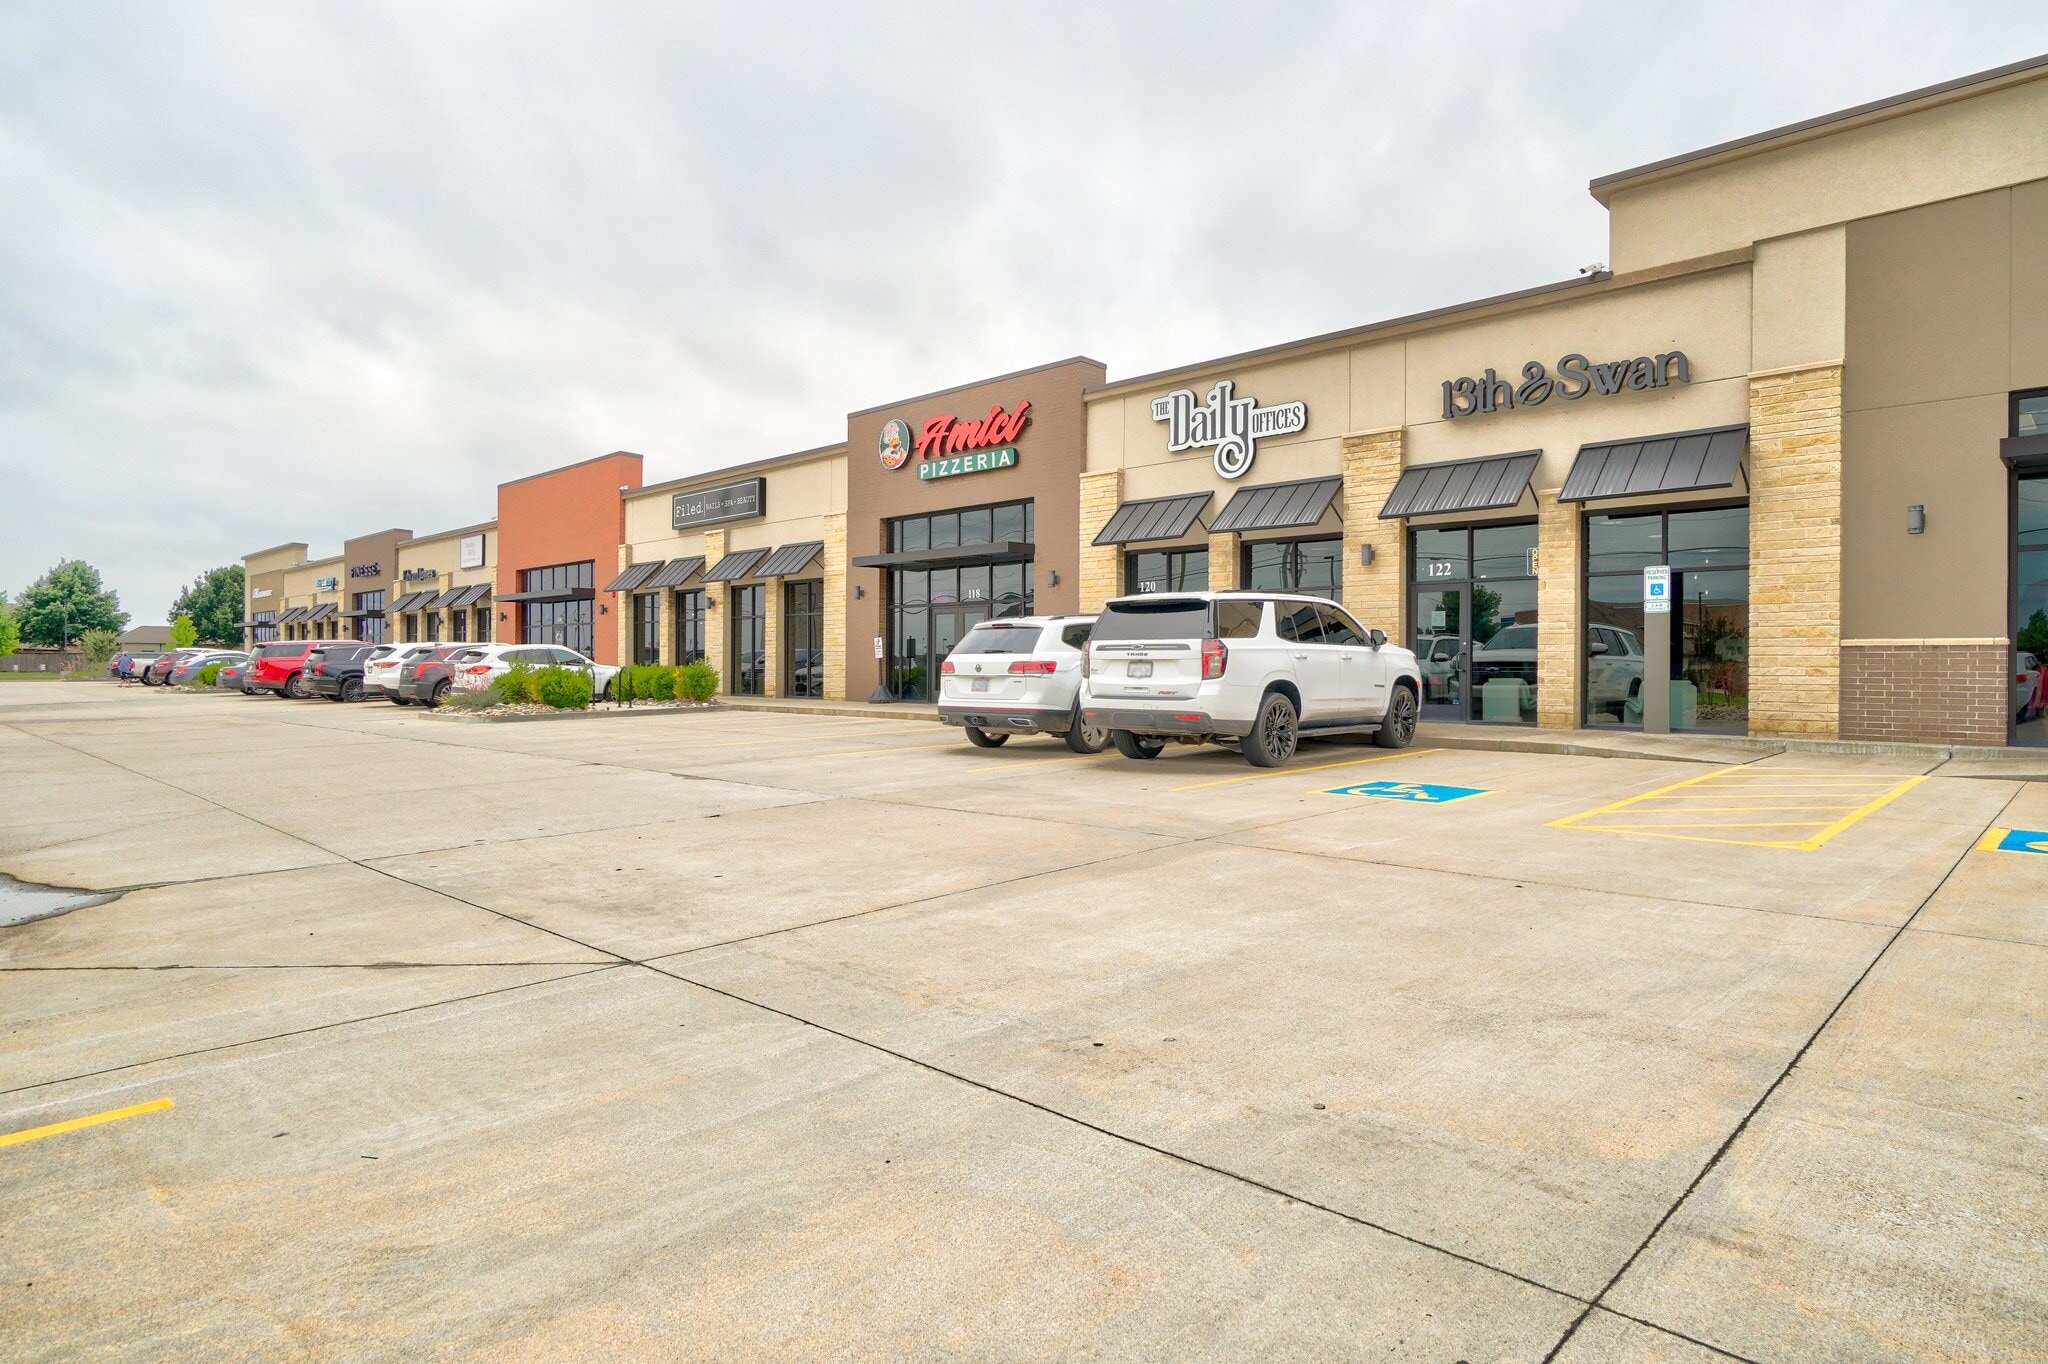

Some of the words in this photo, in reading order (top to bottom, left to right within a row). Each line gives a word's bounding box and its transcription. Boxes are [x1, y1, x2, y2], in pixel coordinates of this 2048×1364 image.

[1441, 368, 1514, 419] 13th
[1555, 350, 1691, 401] Swan
[915, 400, 1032, 459] Amici
[1154, 401, 1170, 416] THE
[1171, 385, 1251, 474] Daily
[1252, 406, 1301, 434] OFFICES
[920, 449, 1011, 479] PIZZERIA
[705, 501, 721, 511] NAILS
[724, 499, 734, 507] SPA
[736, 495, 756, 505] BEAUTY
[1428, 562, 1452, 577] 122
[968, 588, 981, 599] 118
[1140, 581, 1156, 592] 120
